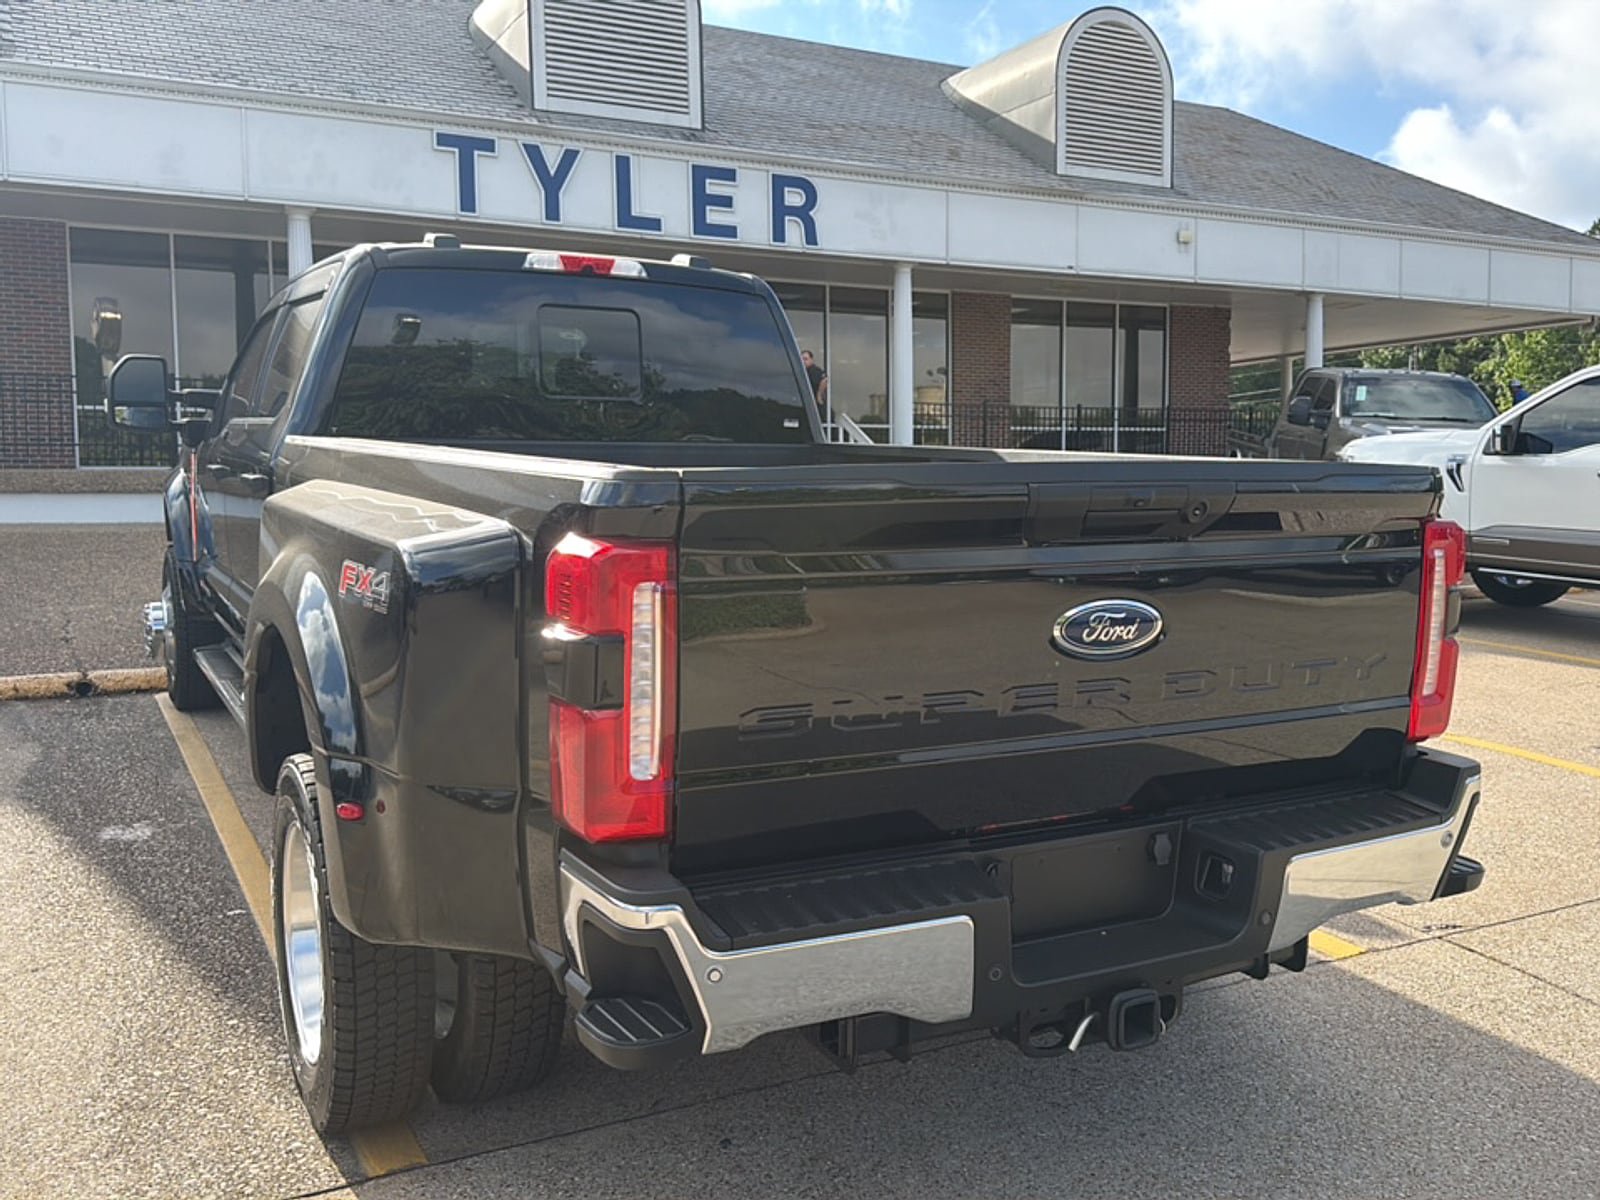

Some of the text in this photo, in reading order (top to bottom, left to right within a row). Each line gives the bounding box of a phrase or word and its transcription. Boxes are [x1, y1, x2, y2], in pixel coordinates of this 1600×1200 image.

[434, 132, 819, 247] TYLER
[338, 559, 391, 606] FX4
[1082, 611, 1140, 643] Ford
[737, 653, 1388, 742] SUPER DUTY
